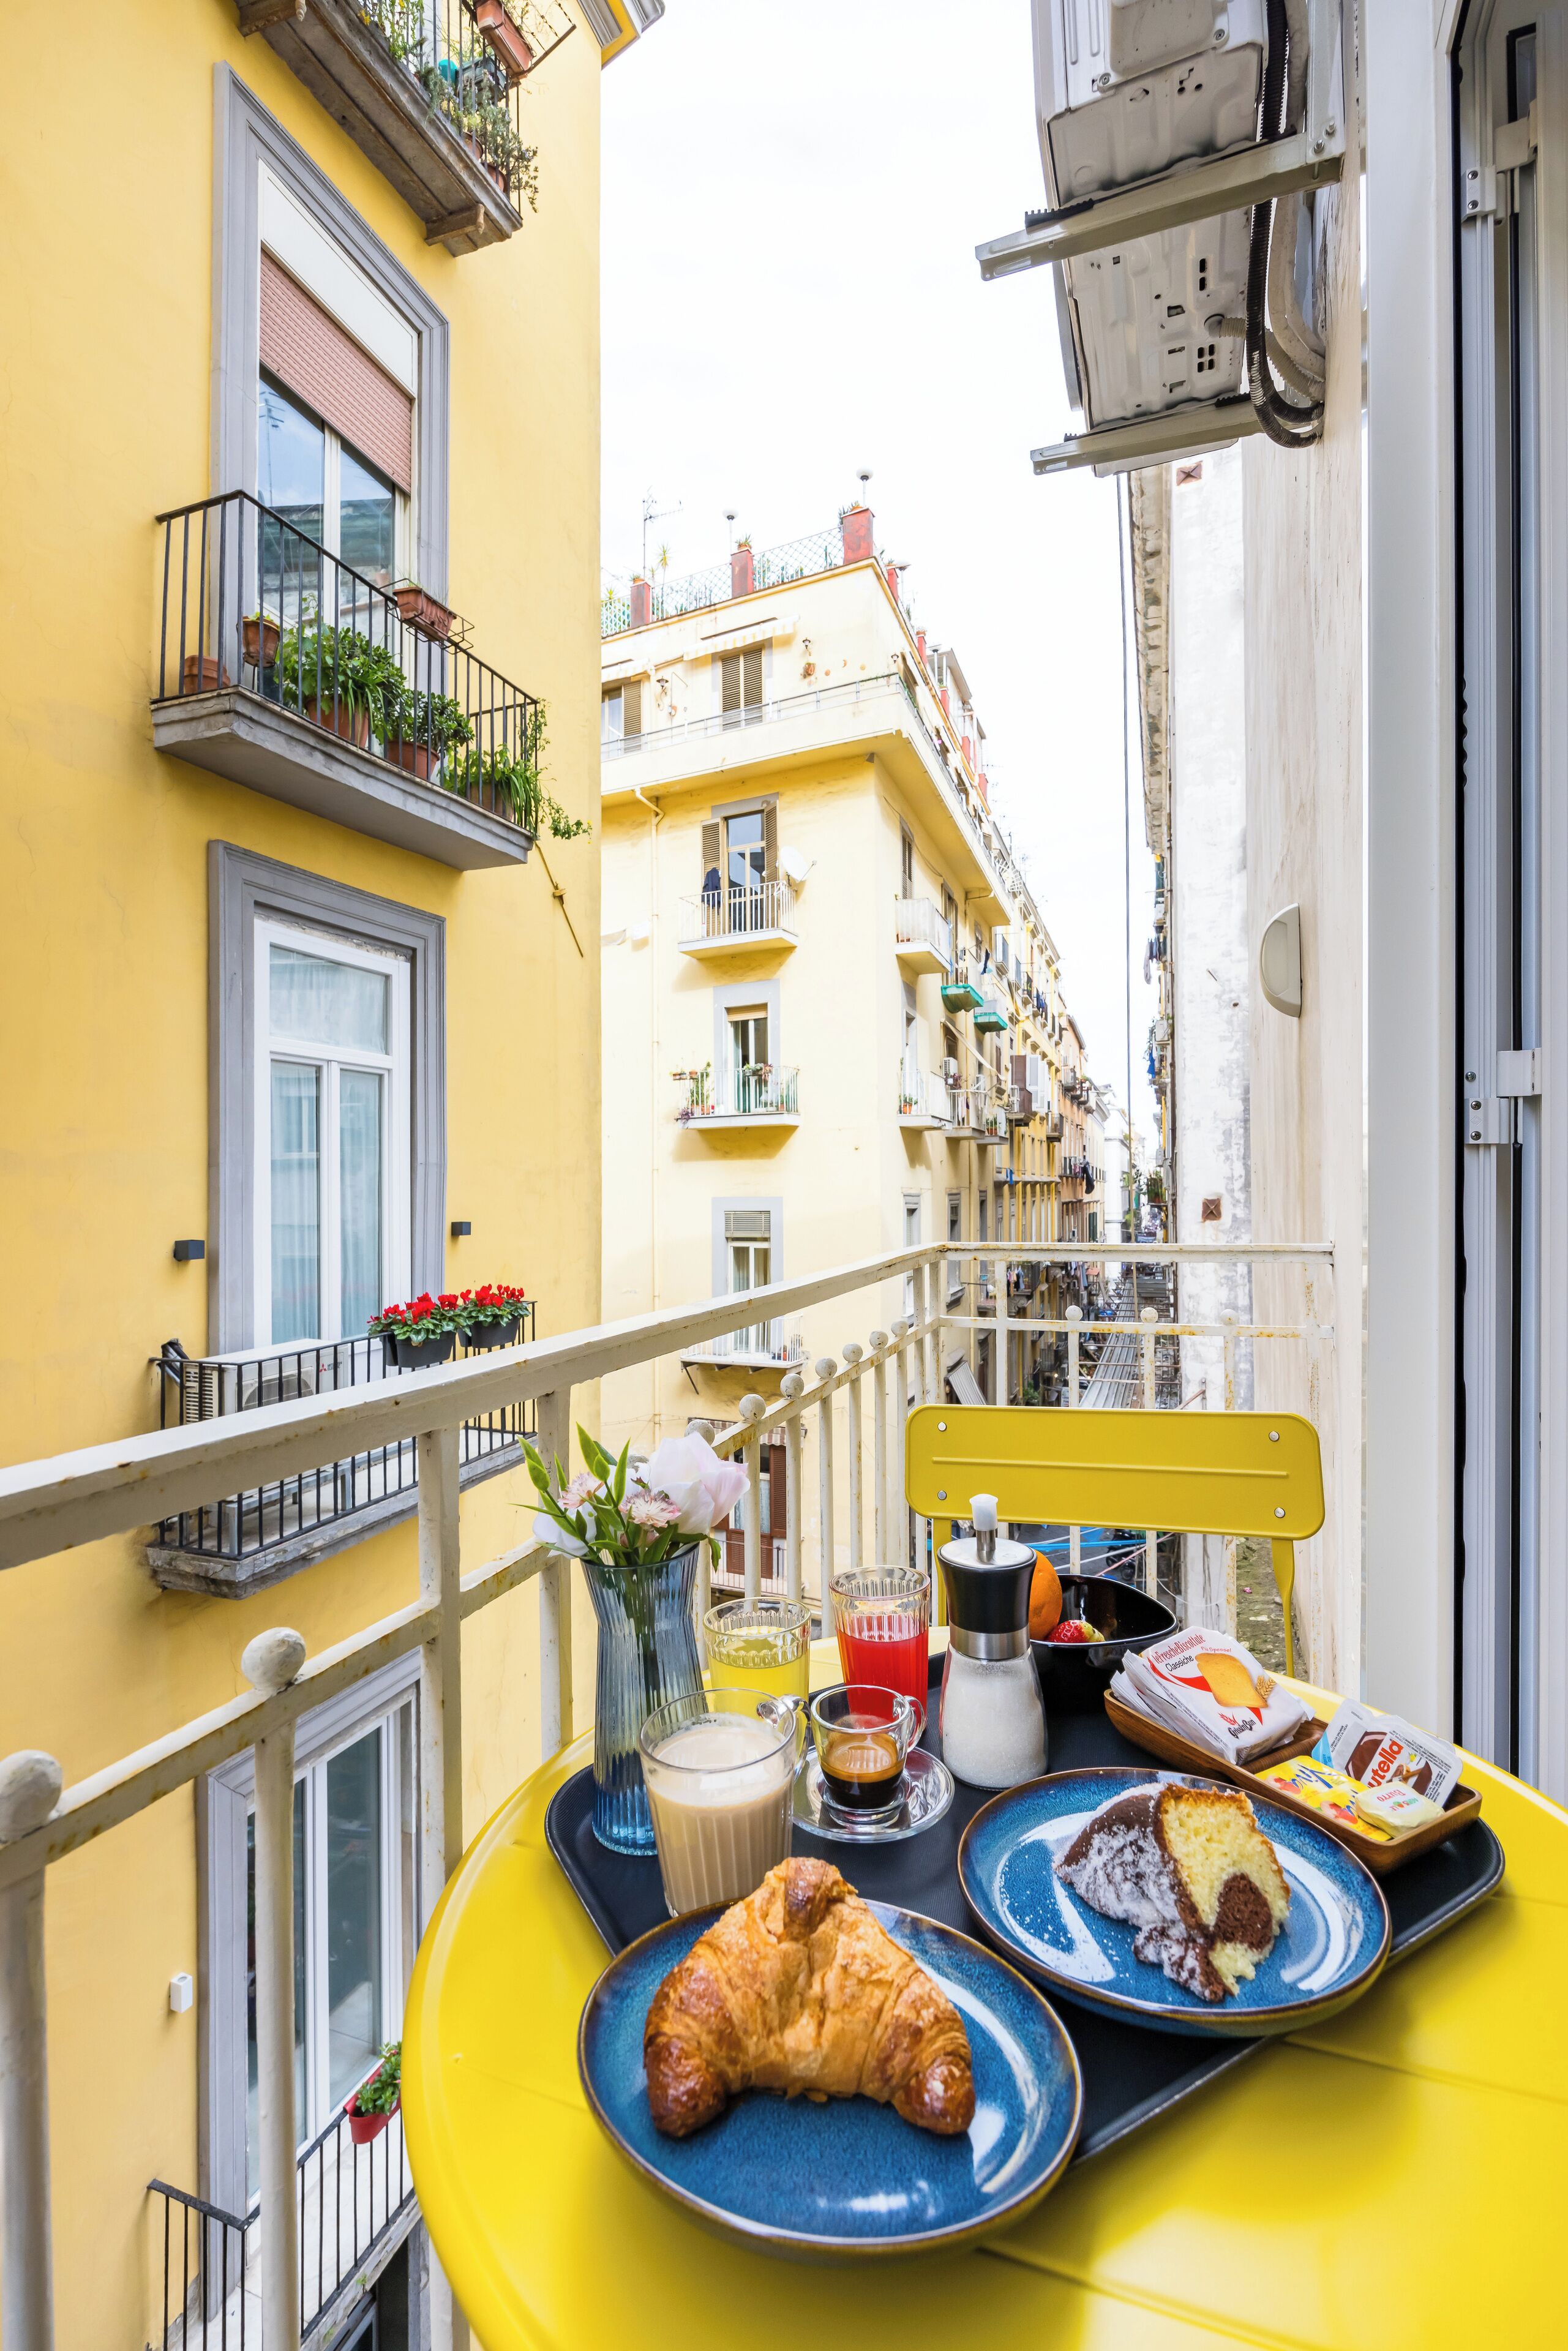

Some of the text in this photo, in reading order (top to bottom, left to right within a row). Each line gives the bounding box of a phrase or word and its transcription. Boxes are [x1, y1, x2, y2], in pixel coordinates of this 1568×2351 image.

[1165, 1654, 1194, 1672] Classiche
[1366, 1739, 1404, 1788] utella
[1376, 1790, 1406, 1802] Burro
